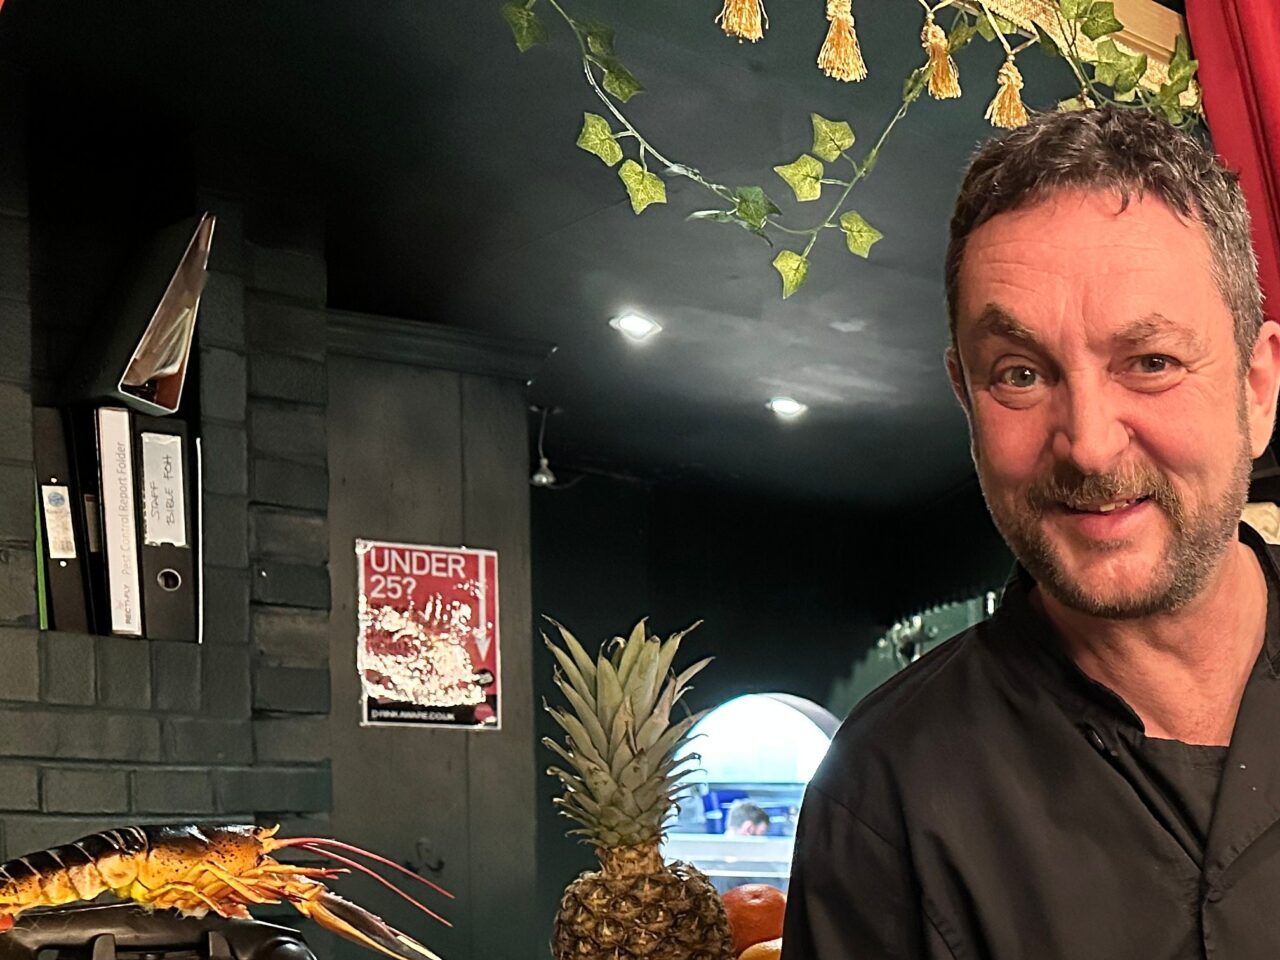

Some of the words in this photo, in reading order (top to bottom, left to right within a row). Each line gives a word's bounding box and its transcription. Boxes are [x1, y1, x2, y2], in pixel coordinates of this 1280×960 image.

[116, 442, 127, 475] Folder
[118, 477, 129, 512] Report
[119, 514, 130, 552] Control
[121, 555, 130, 576] Pest
[370, 548, 466, 579] UNDER
[369, 574, 417, 600] 25?
